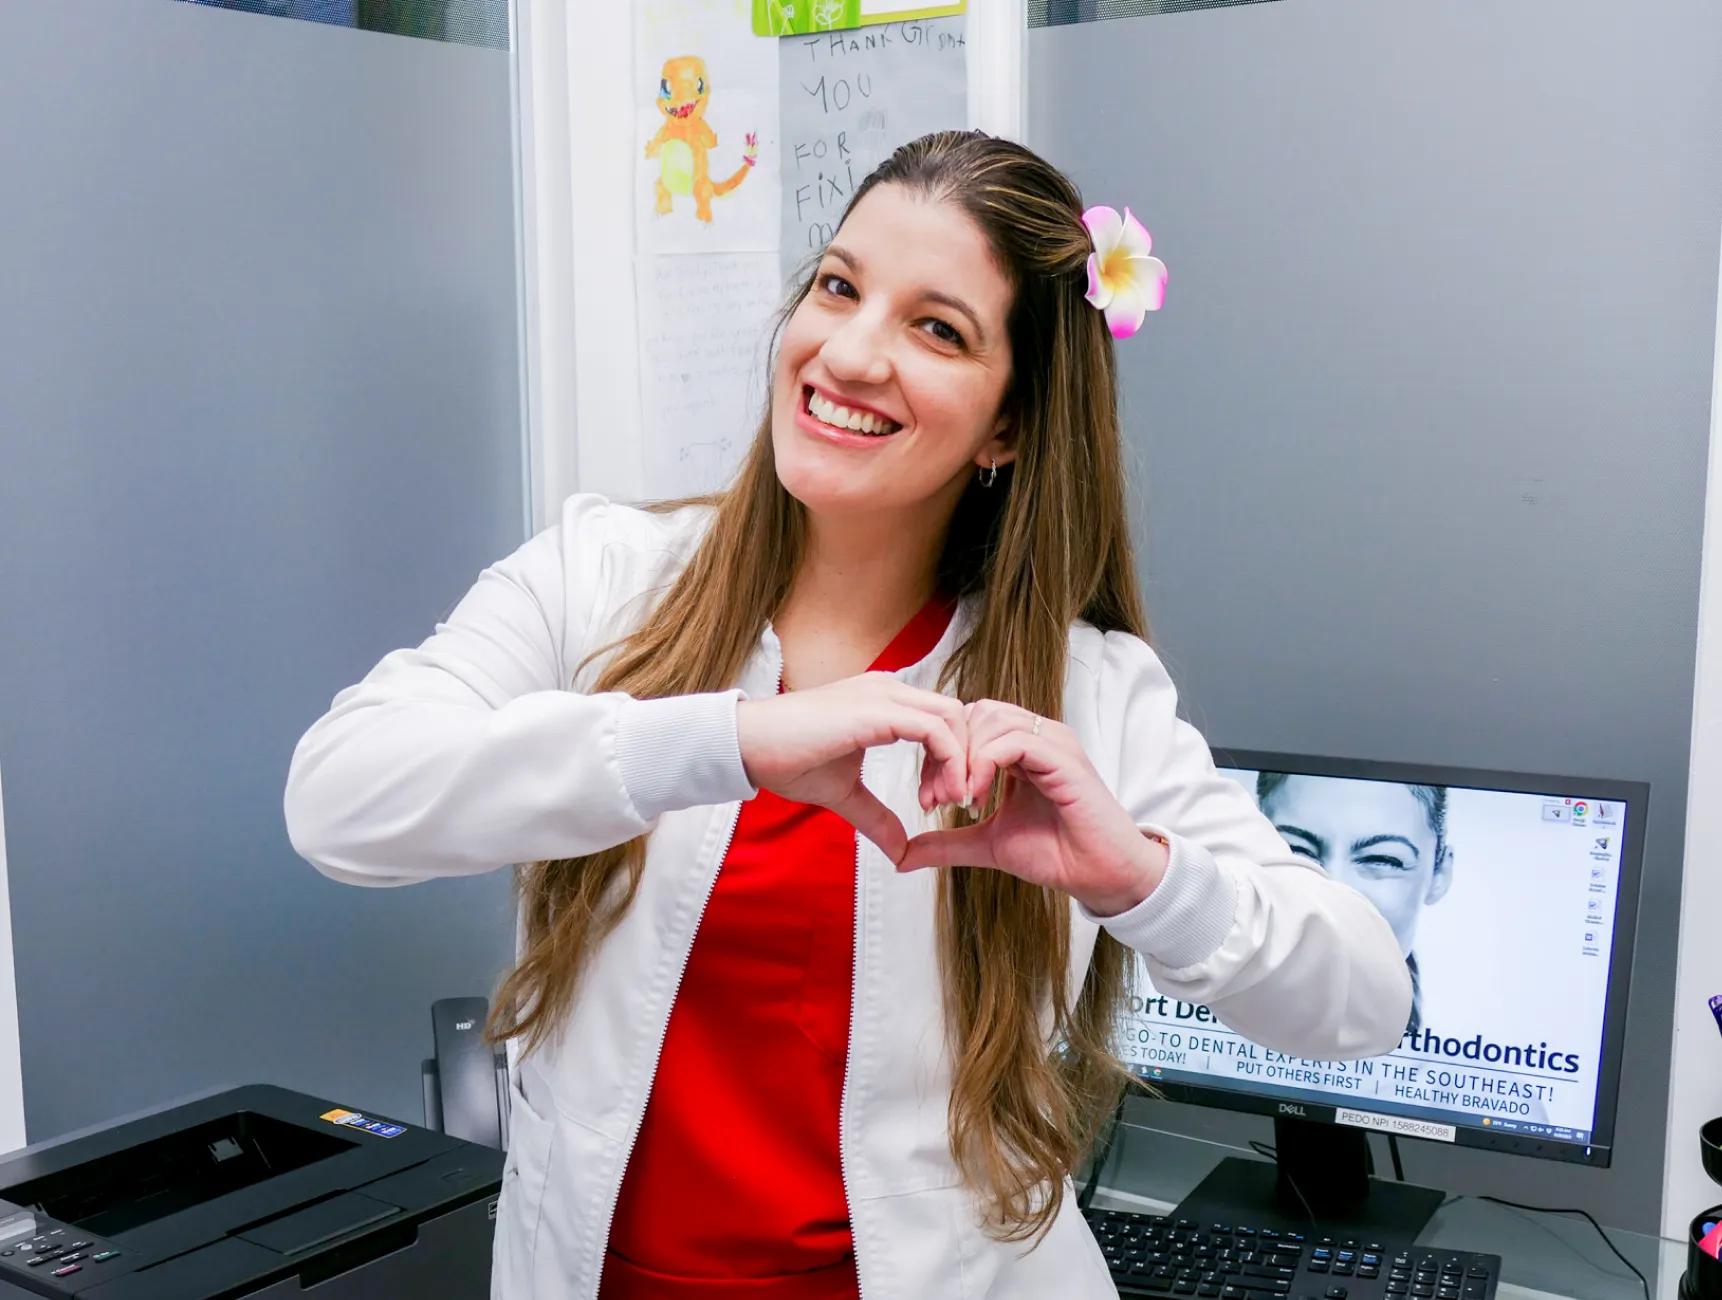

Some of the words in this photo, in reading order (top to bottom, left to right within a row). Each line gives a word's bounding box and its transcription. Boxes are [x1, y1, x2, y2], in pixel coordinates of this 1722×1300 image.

[803, 22, 892, 61] THANK
[800, 73, 871, 113] YOU
[795, 131, 850, 170] FOR
[1175, 1000, 1218, 1023] De
[1397, 1027, 1579, 1074] rthodontics
[1141, 1046, 1187, 1064] TODAY!
[1188, 1035, 1258, 1060] DENTAL
[1354, 1059, 1374, 1076] IN
[1381, 1063, 1419, 1083] THE
[1425, 1069, 1555, 1102] SOUTHEAST!
[1236, 1060, 1264, 1076] PUT
[1266, 1065, 1321, 1085] OTHERS
[1323, 1073, 1362, 1090] FIRST
[1278, 1103, 1307, 1117] DELL
[1395, 1084, 1460, 1105] HEALTHY
[1461, 1094, 1530, 1116] BRAVADO
[1341, 1111, 1370, 1125] PEDO
[1372, 1117, 1390, 1127] NPI
[1392, 1120, 1450, 1138] 1588245088
